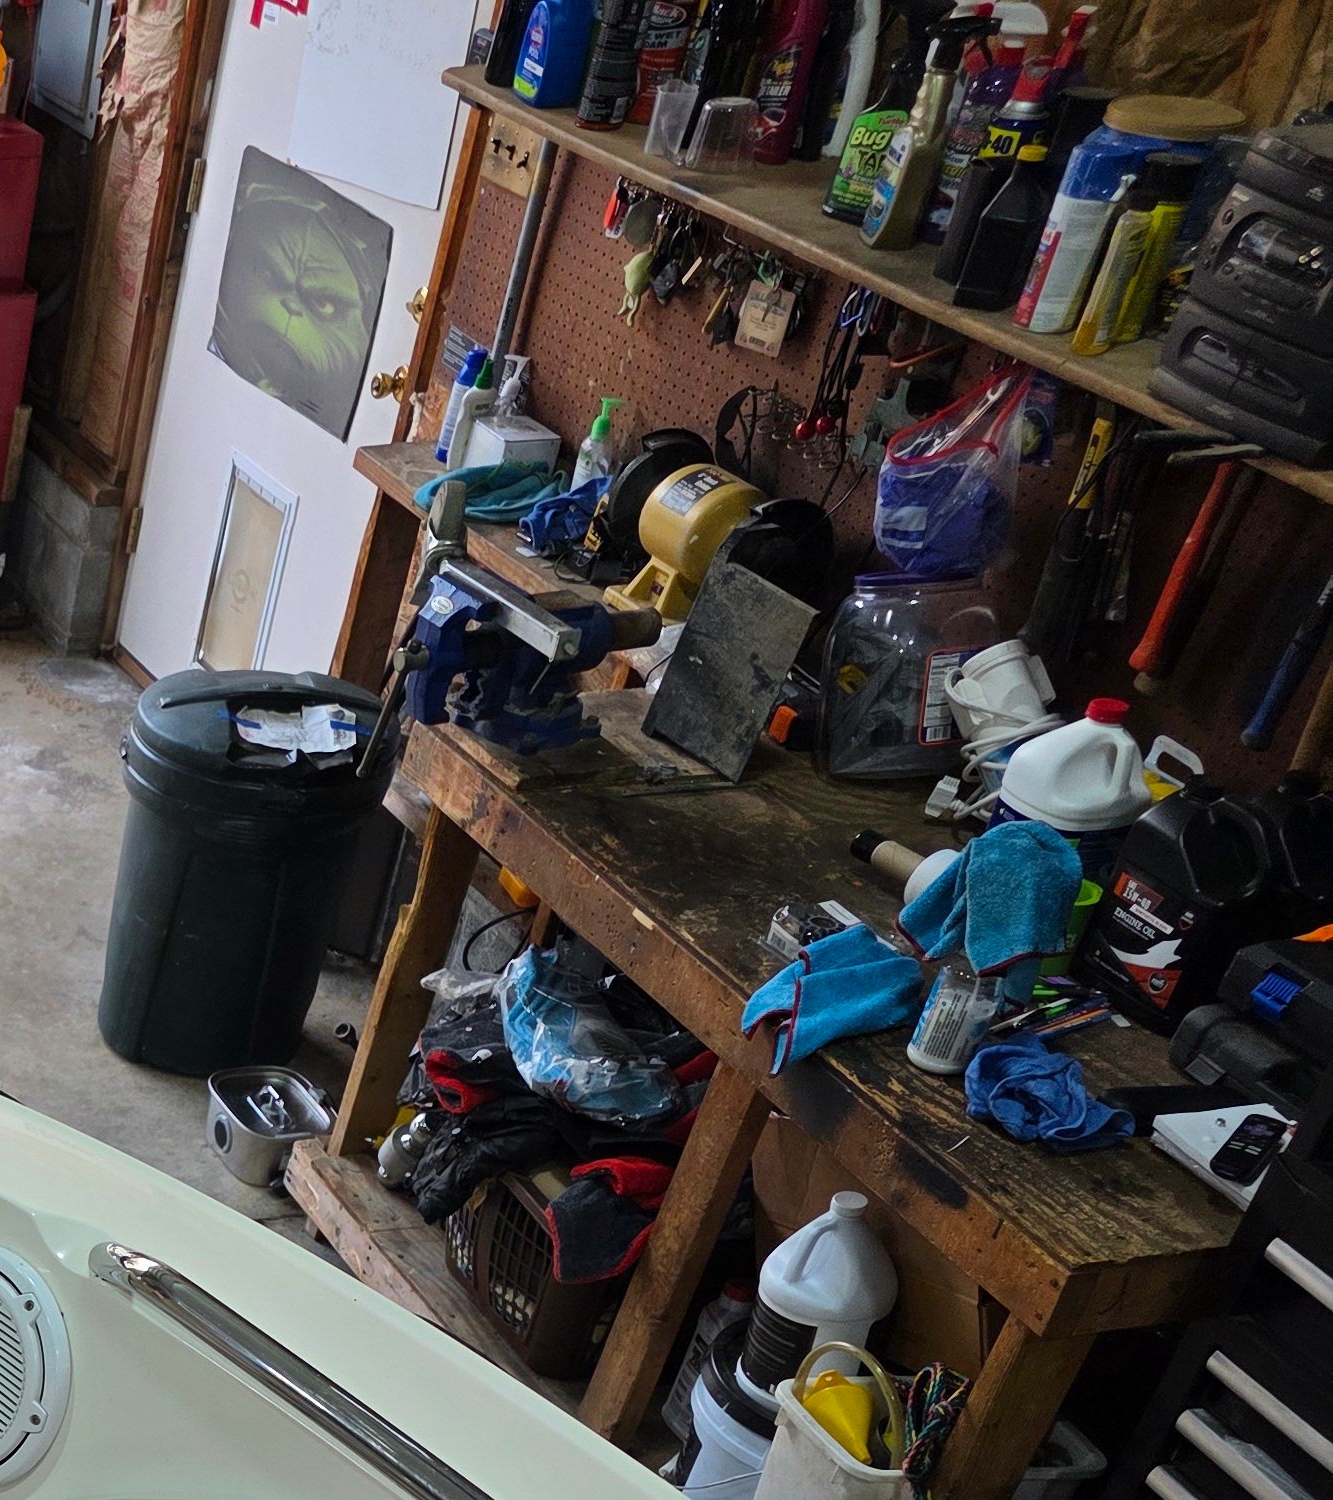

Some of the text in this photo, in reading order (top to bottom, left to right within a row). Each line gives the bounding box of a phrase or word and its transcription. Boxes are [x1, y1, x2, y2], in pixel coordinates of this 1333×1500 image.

[850, 127, 893, 150] Bug
[1113, 906, 1156, 940] ENGINE OIL
